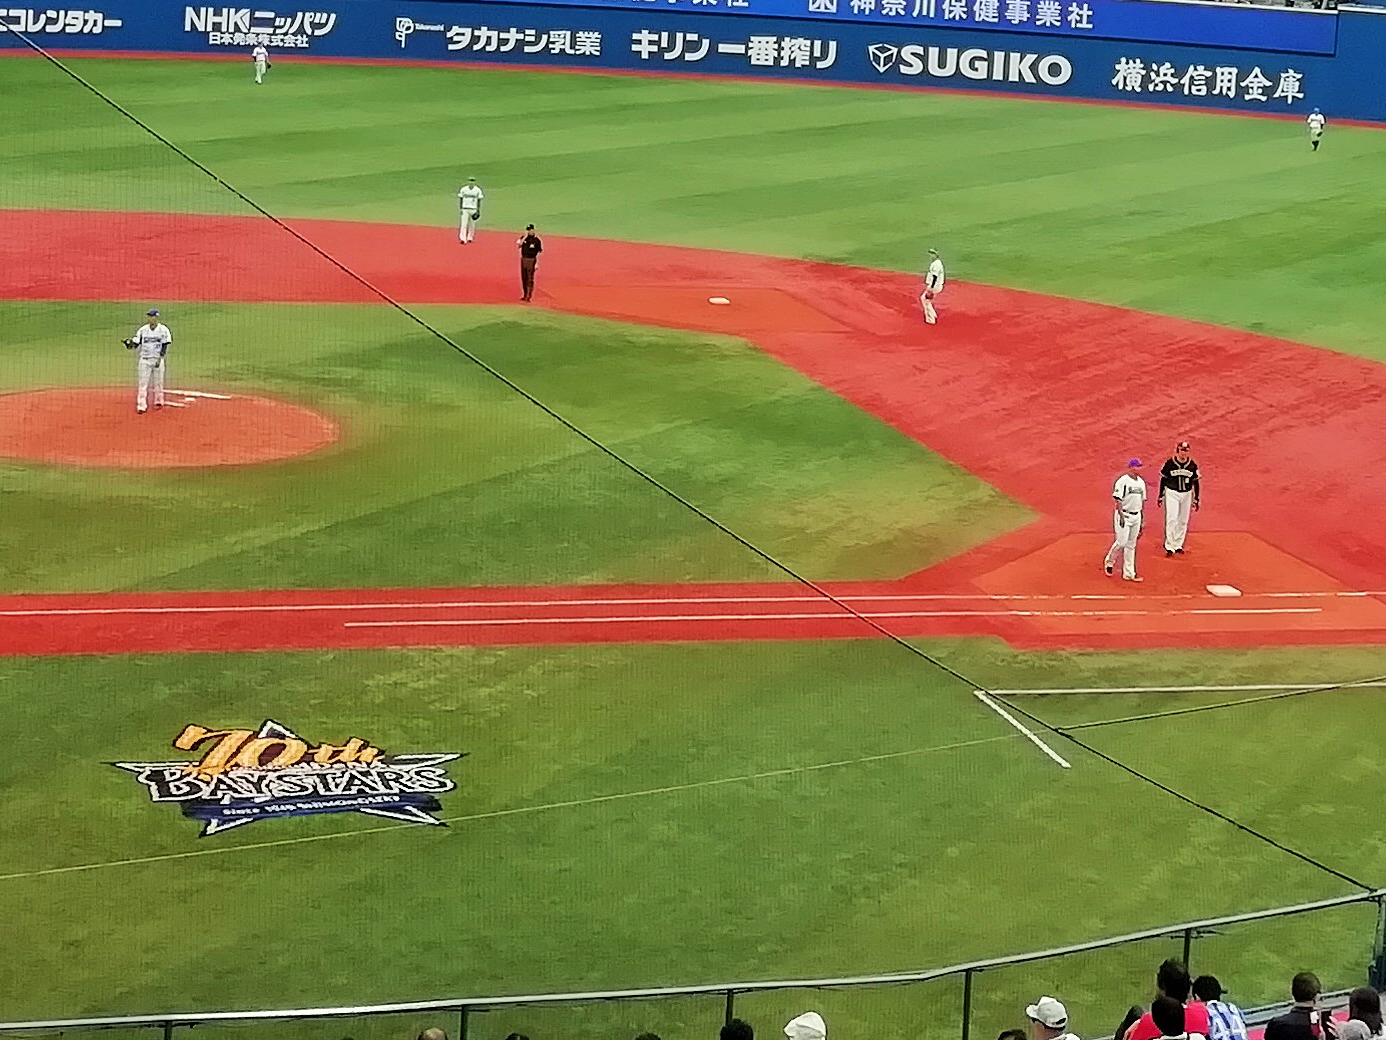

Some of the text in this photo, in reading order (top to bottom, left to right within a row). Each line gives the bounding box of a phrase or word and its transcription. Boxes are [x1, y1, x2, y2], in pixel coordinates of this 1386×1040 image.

[446, 25, 601, 56] タカナシ乳業
[899, 45, 1072, 86] SUGIKO
[1111, 57, 1304, 104] 横浜信用金庫
[137, 766, 458, 803] BAYSTARS
